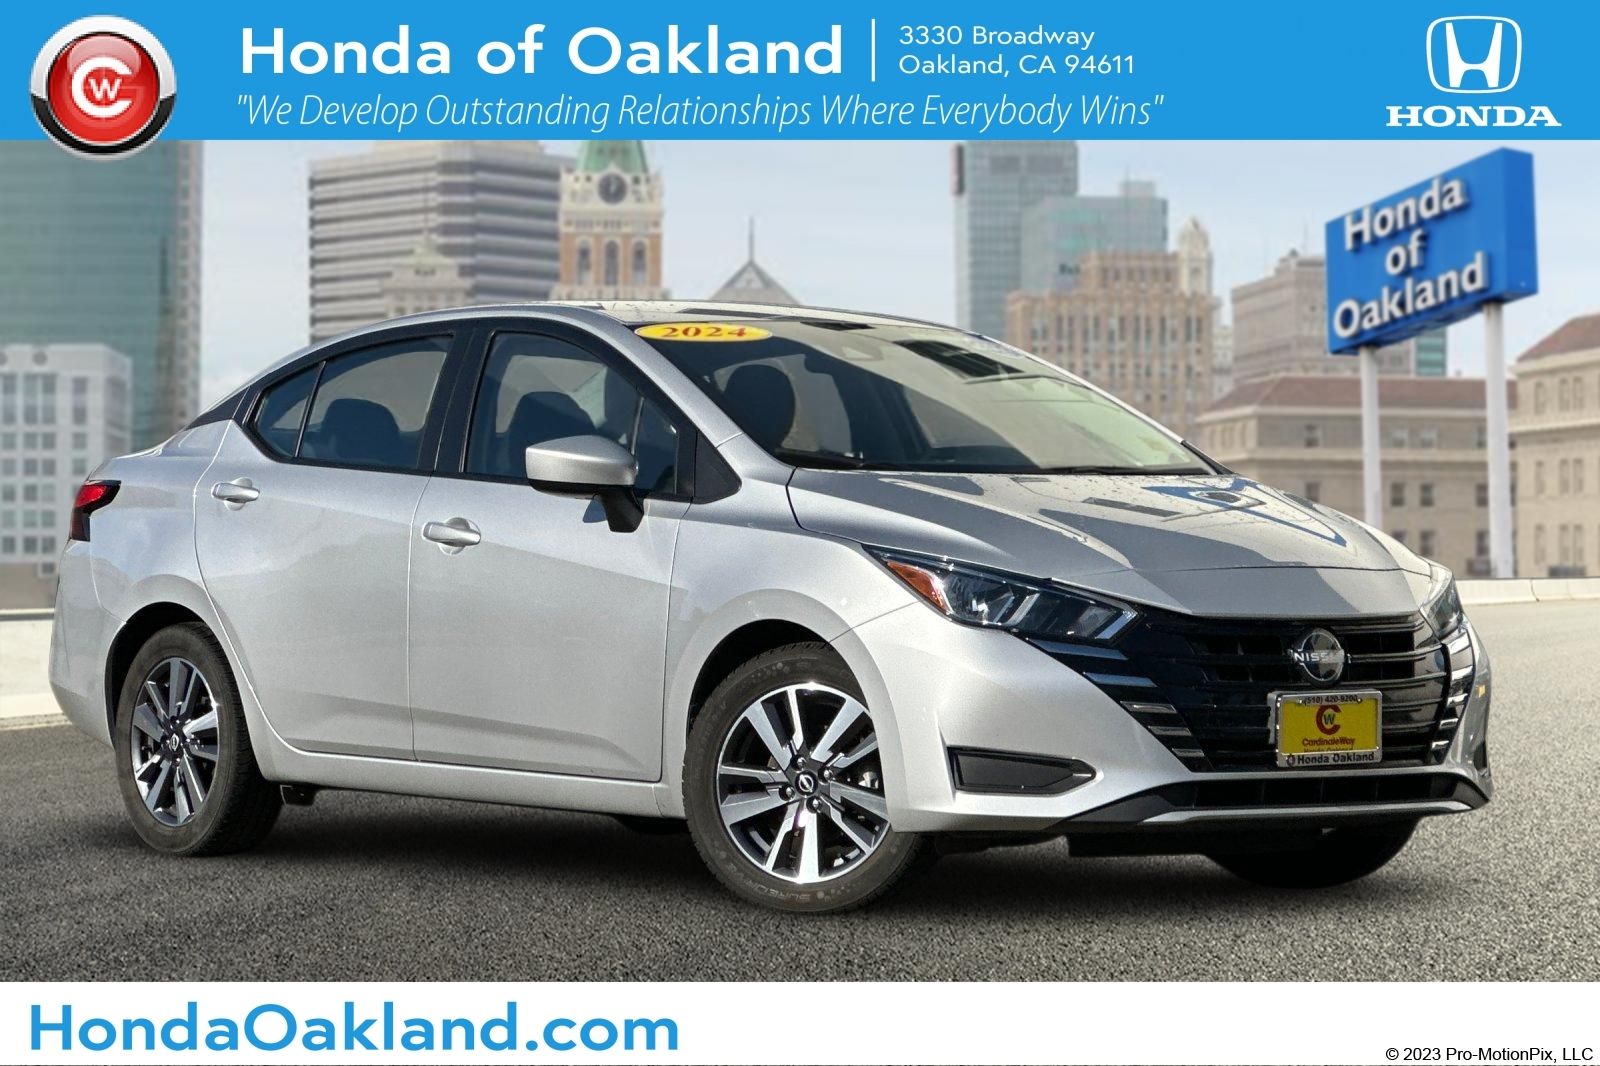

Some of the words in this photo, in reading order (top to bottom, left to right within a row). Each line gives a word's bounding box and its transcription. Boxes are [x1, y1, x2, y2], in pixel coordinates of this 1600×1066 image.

[1344, 175, 1468, 251] Honda
[1385, 229, 1426, 276] of
[1333, 251, 1490, 339] Oakland
[661, 326, 747, 337] 2024
[1297, 753, 1330, 765] Honda
[1332, 751, 1375, 763] Oakland
